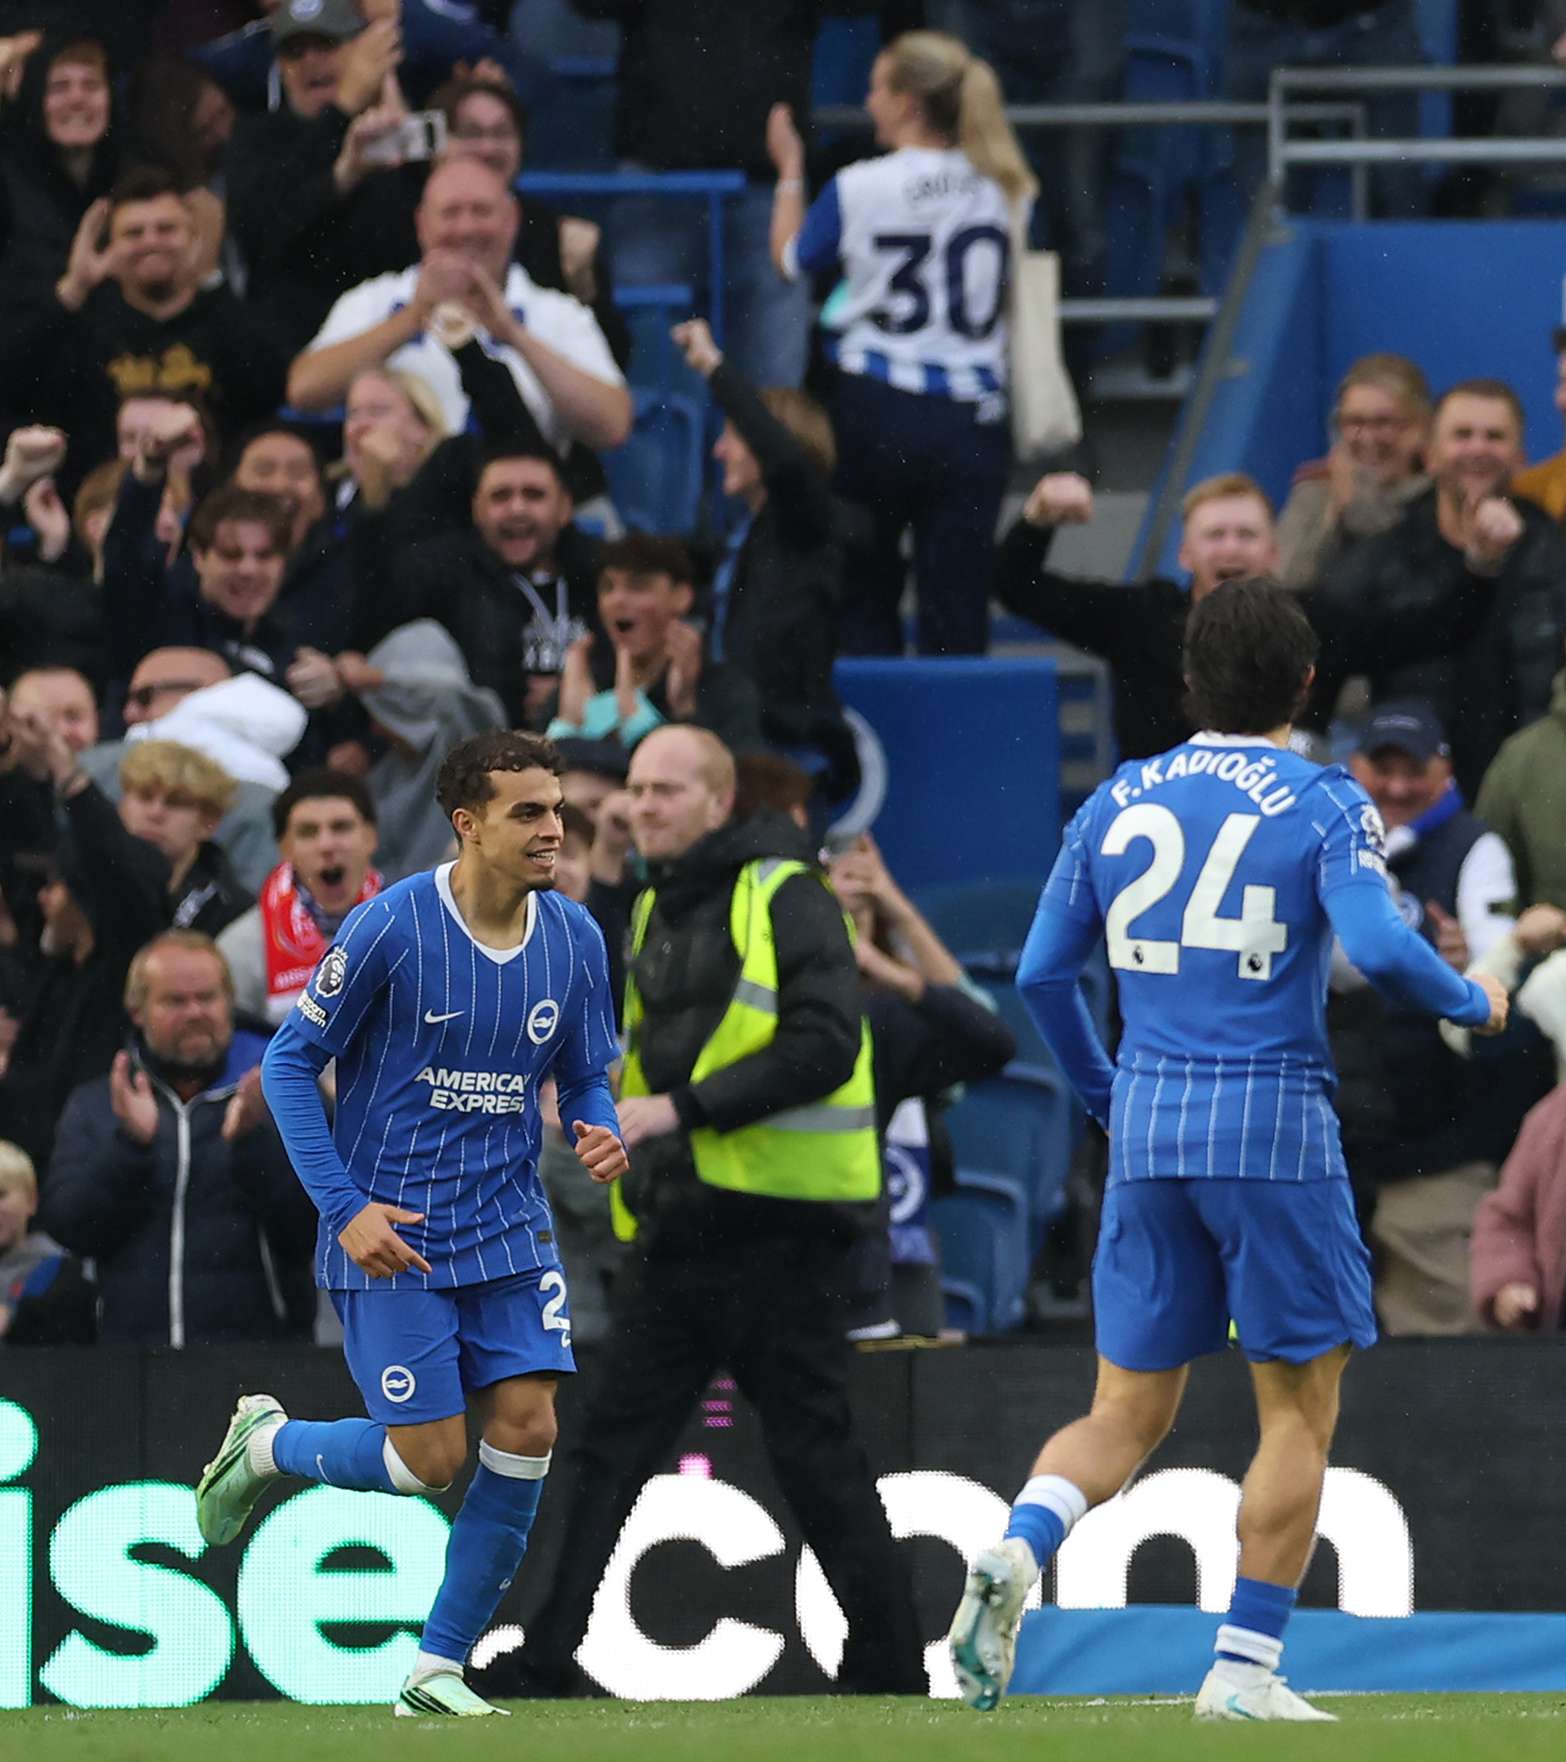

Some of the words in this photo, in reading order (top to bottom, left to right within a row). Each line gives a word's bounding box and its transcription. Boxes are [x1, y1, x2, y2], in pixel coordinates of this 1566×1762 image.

[866, 226, 1010, 340] 30
[1101, 803, 1287, 981] 24
[414, 1066, 531, 1093] AMERICA
[430, 1089, 525, 1114] EXPRES
[539, 1271, 571, 1330] 2
